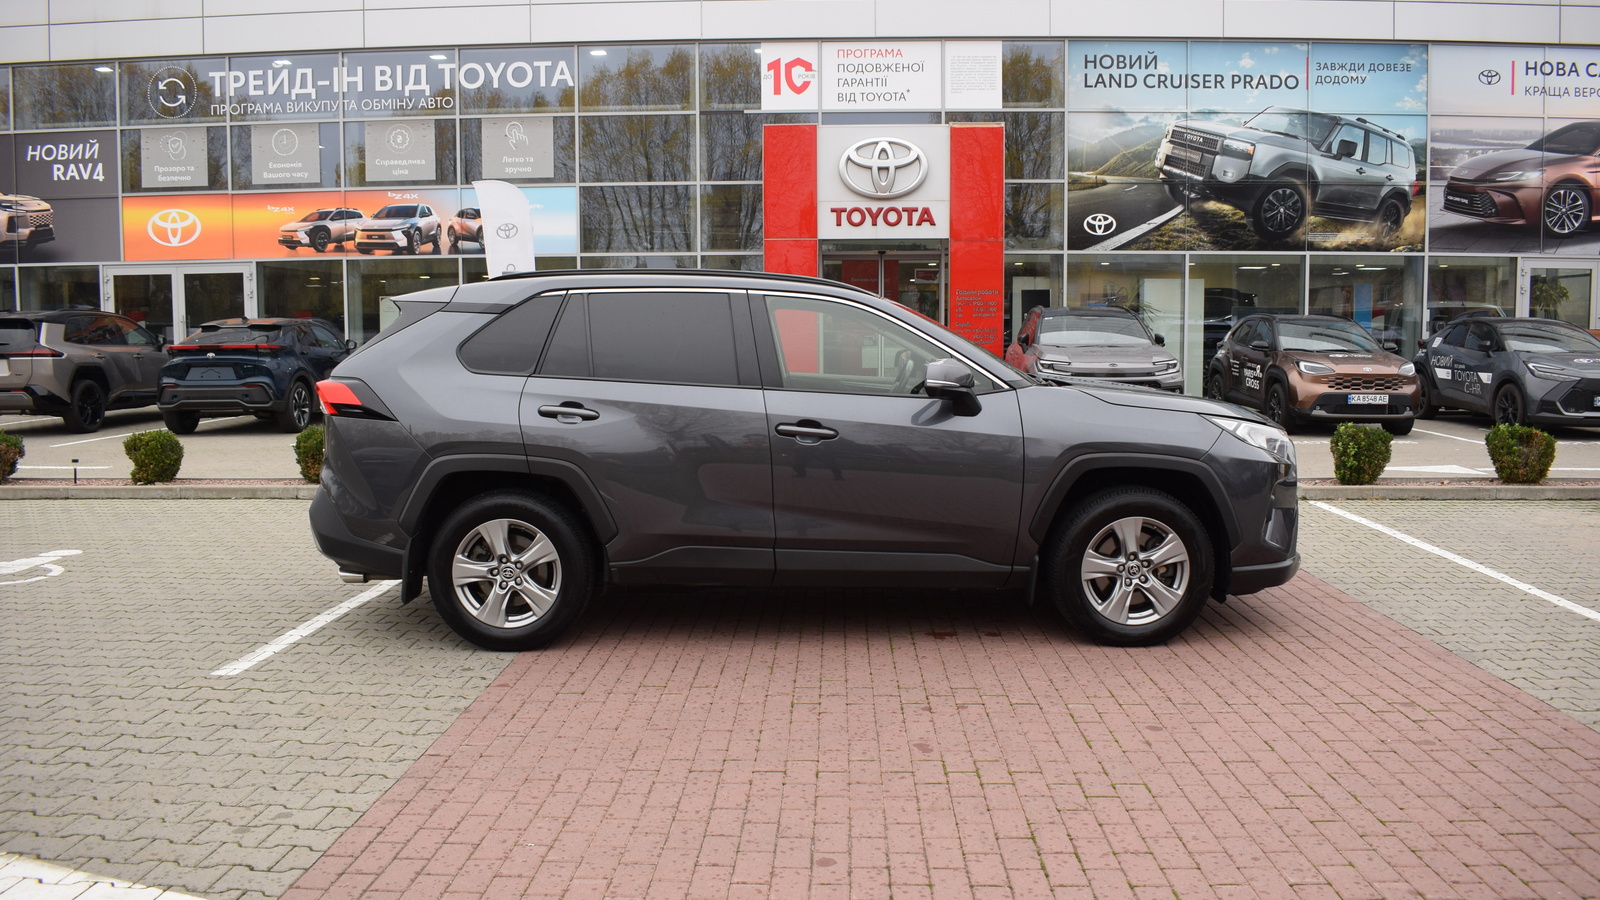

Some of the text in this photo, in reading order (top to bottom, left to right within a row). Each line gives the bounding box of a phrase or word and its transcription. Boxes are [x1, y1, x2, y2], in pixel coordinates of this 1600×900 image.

[837, 49, 904, 59] ПРОГРАМА
[1084, 51, 1158, 70] НОВИЙ
[837, 60, 926, 75] ПОДОВЖЕНОЇ
[1315, 62, 1412, 73] ЗАВЖДИ ДОВЕЗЕ
[1525, 60, 1600, 78] НОВА C
[209, 60, 575, 100] ТРЕЙД-ІН ВІД TOYOTA
[837, 75, 889, 88] ГАРАНТІЇ
[1084, 73, 1300, 91] LAND CRUISER PRADO
[1315, 75, 1368, 86] ДОДОМУ
[837, 92, 857, 104] ВІД
[1524, 85, 1571, 99] КРАЩА
[211, 97, 454, 116] ПРОГРАМА ВИКУПУ ТА ОБМІНУ АВТО
[1184, 133, 1203, 143] TOYOTA
[27, 138, 100, 162] НОВИЙ
[268, 161, 302, 169] Економія
[375, 158, 426, 167] Справедлива
[502, 156, 525, 164] Легко
[53, 162, 105, 182] RAV4
[154, 165, 185, 174] Прозоро
[263, 171, 309, 179] Вашого часу
[392, 168, 409, 176] ціна
[504, 166, 532, 175] зручно
[157, 173, 192, 182] безпечно
[830, 206, 937, 227] TOYOTA
[1430, 354, 1454, 367] НОВИЙ
[1454, 369, 1479, 383] TOYOTA
[1245, 377, 1260, 390] CROSS
[1464, 382, 1482, 395] C-HR
